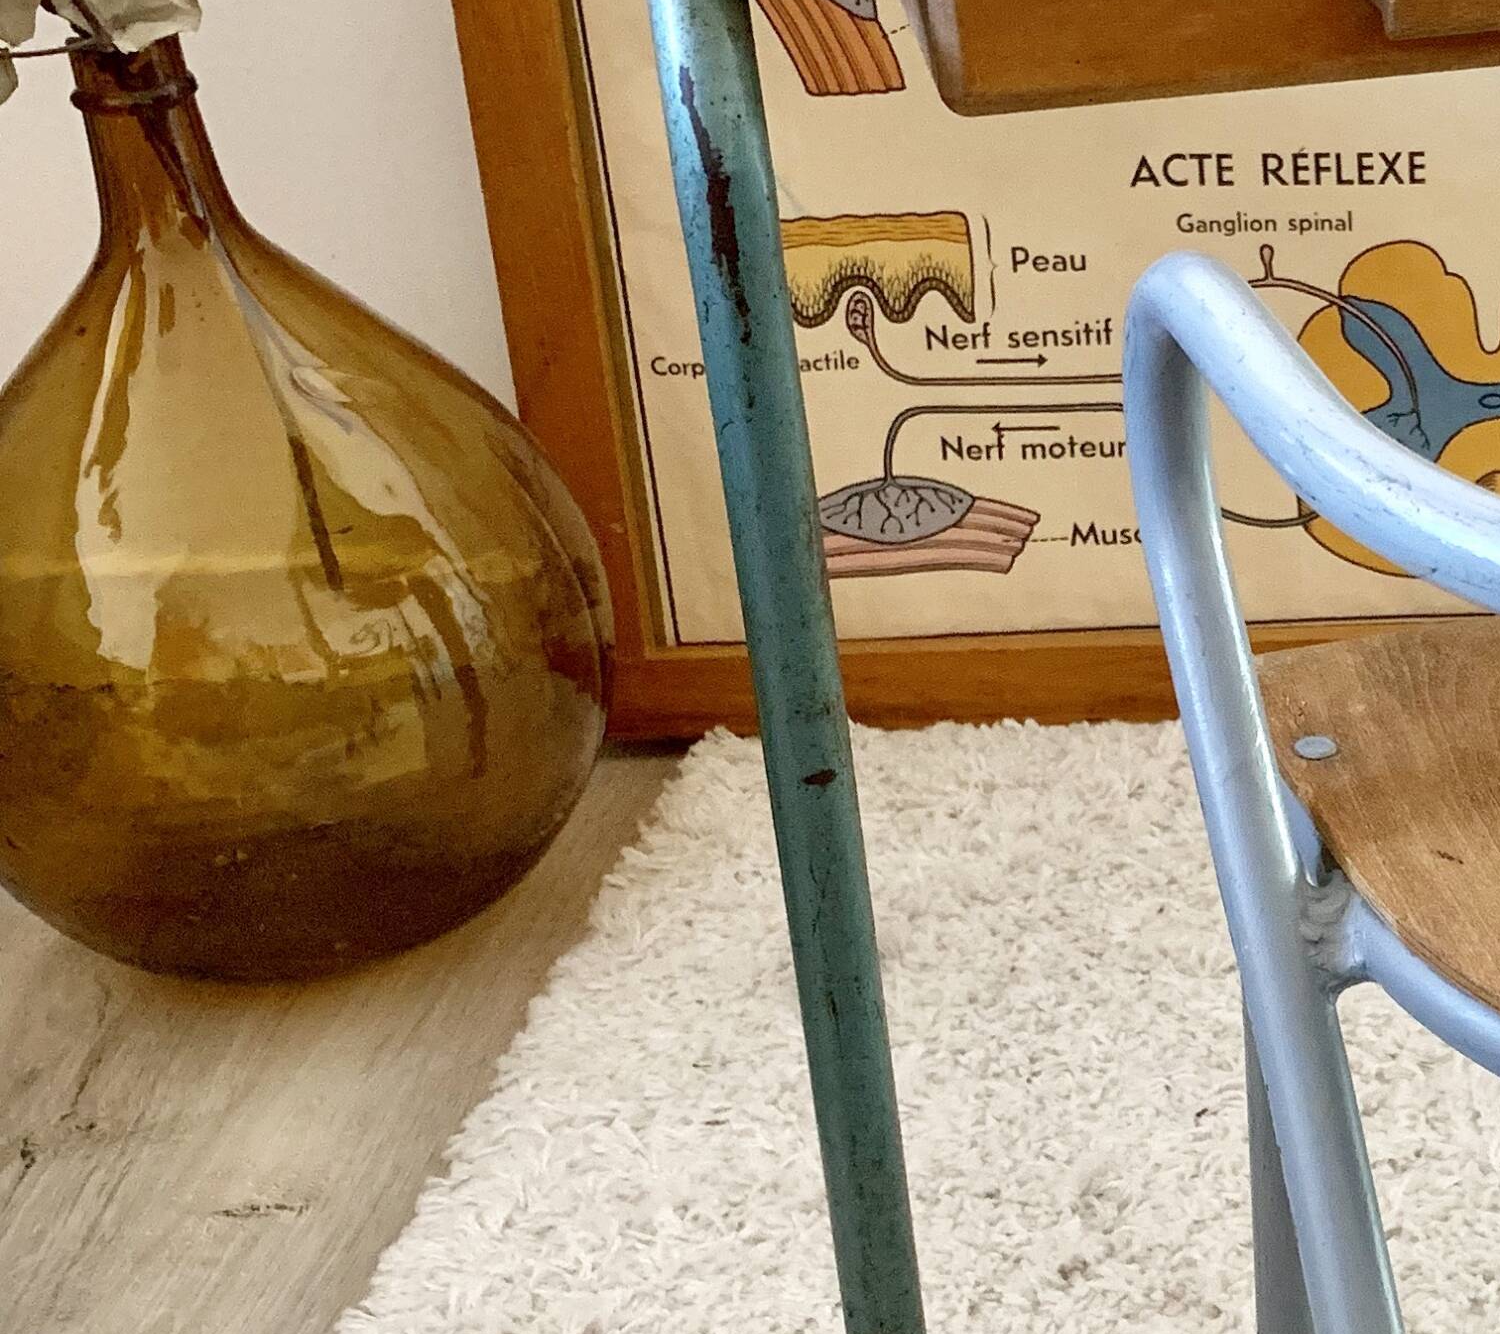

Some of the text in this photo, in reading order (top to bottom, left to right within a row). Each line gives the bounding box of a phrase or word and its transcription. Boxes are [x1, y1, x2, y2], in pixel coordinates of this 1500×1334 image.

[1130, 147, 1427, 188] ACTE RÉFLEXE
[1176, 210, 1353, 237] Ganglion spinal
[1010, 246, 1088, 274] Peau
[925, 319, 1114, 352] Nerf sensitif
[798, 351, 861, 374] actile
[940, 429, 1126, 463] Nerf moteur
